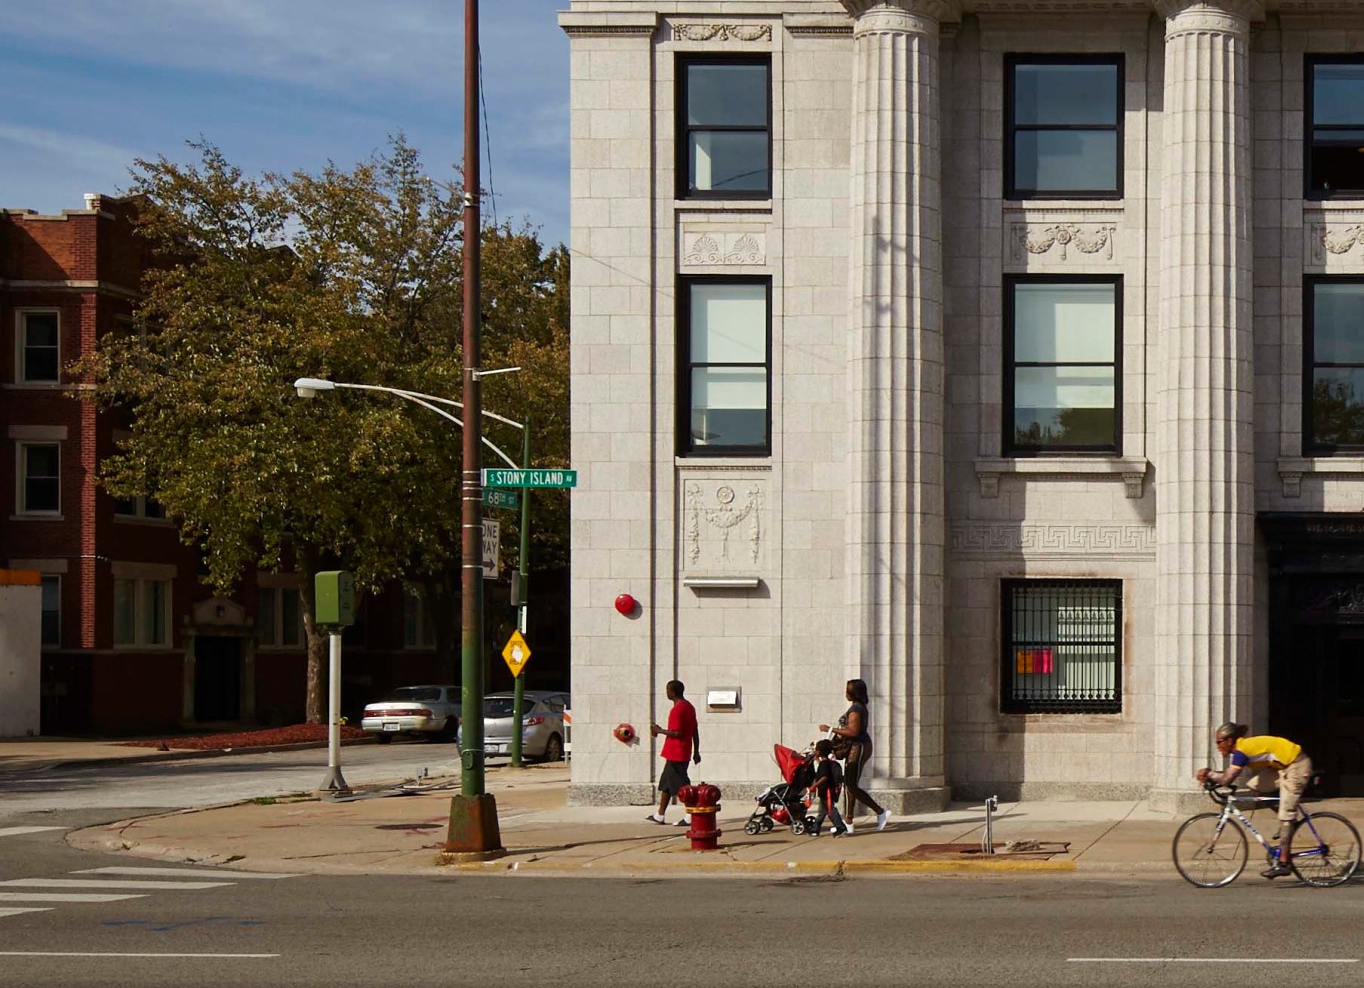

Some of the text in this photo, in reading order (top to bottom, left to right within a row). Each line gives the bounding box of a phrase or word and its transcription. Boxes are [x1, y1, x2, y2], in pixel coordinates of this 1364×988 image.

[490, 474, 495, 482] S
[496, 471, 526, 485] STONY
[530, 471, 564, 485] ISLAND
